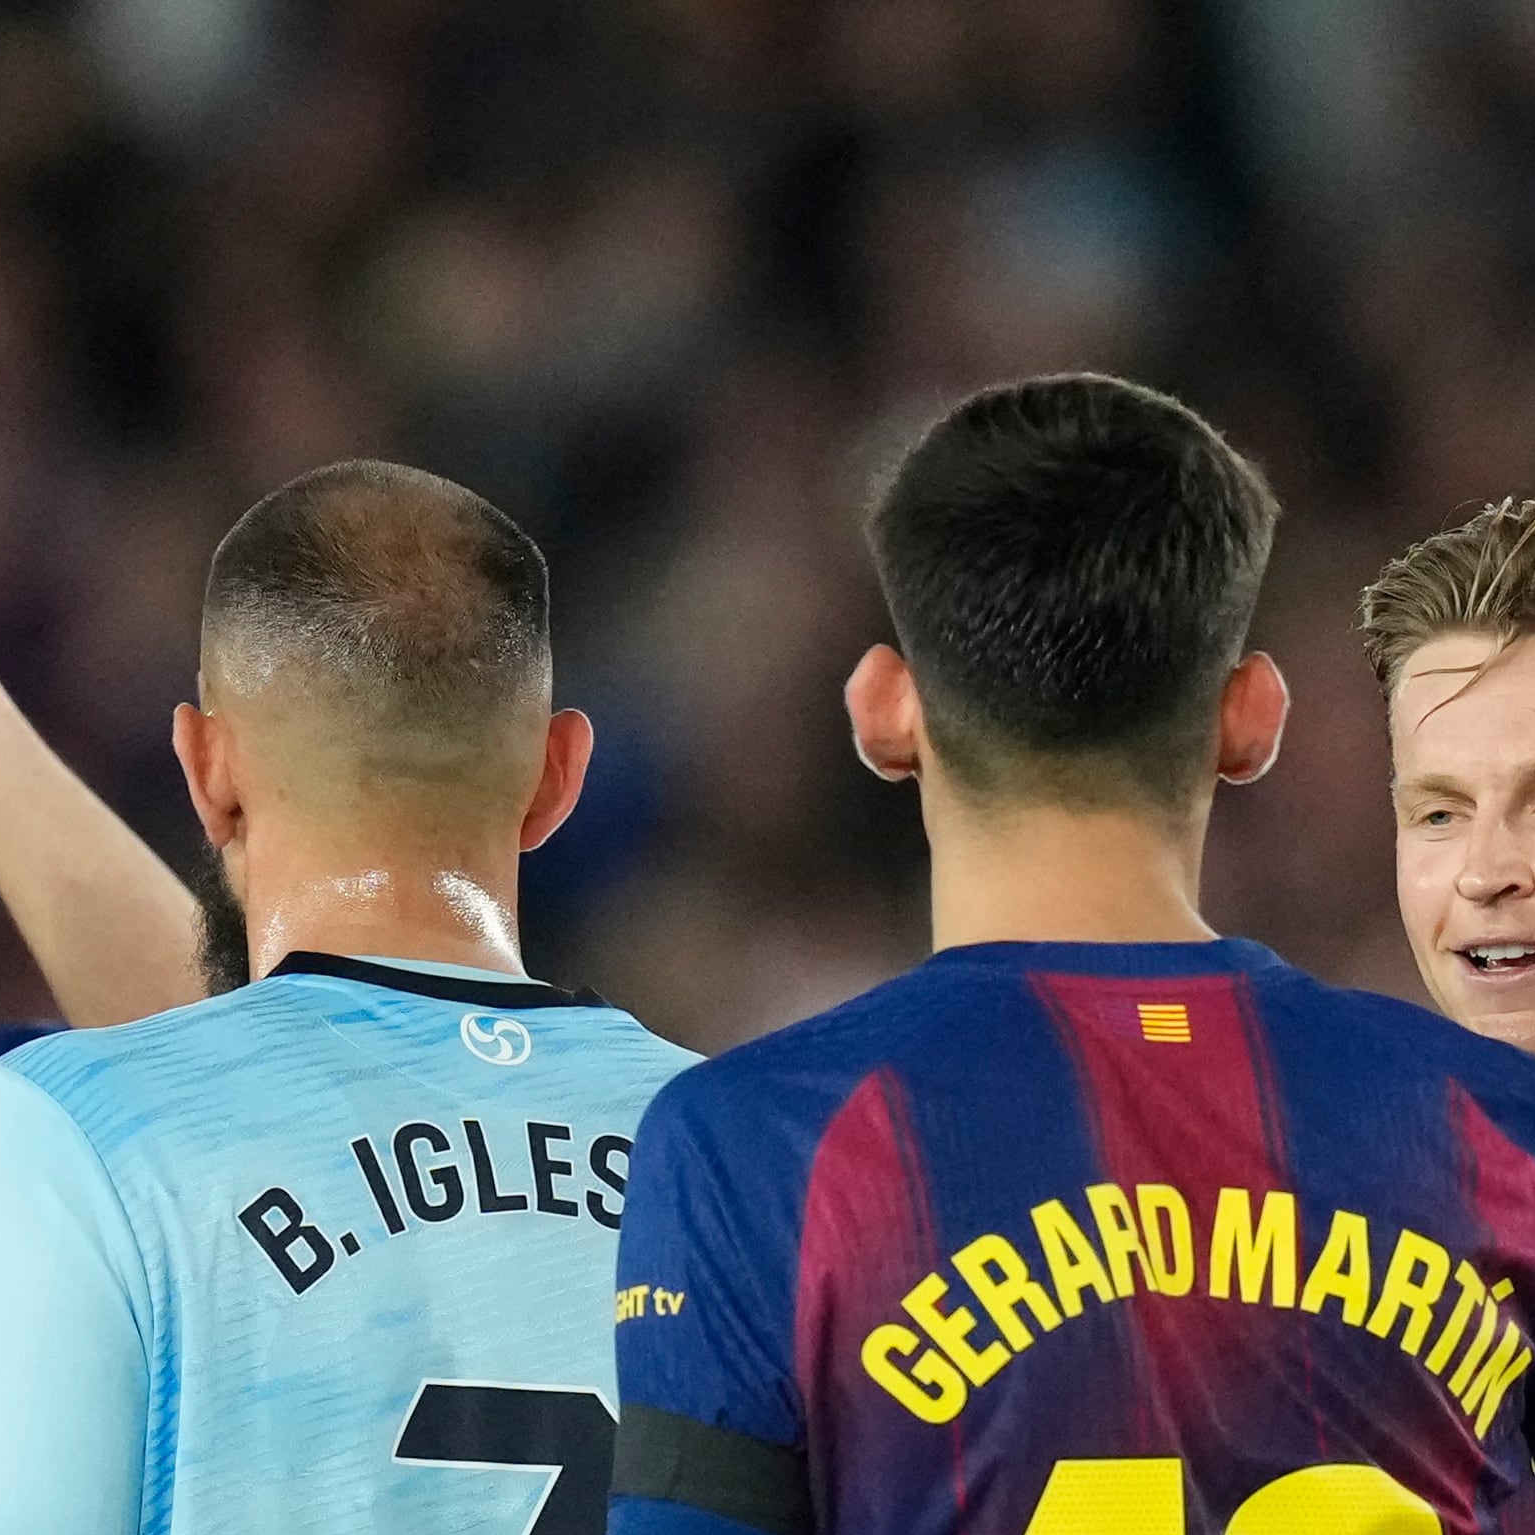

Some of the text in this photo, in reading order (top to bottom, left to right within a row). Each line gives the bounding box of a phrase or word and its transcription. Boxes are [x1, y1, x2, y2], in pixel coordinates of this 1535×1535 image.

[237, 1186, 362, 1296] B.
[652, 1286, 686, 1316] tv
[860, 1182, 1533, 1442] GERARD MARTÍN
